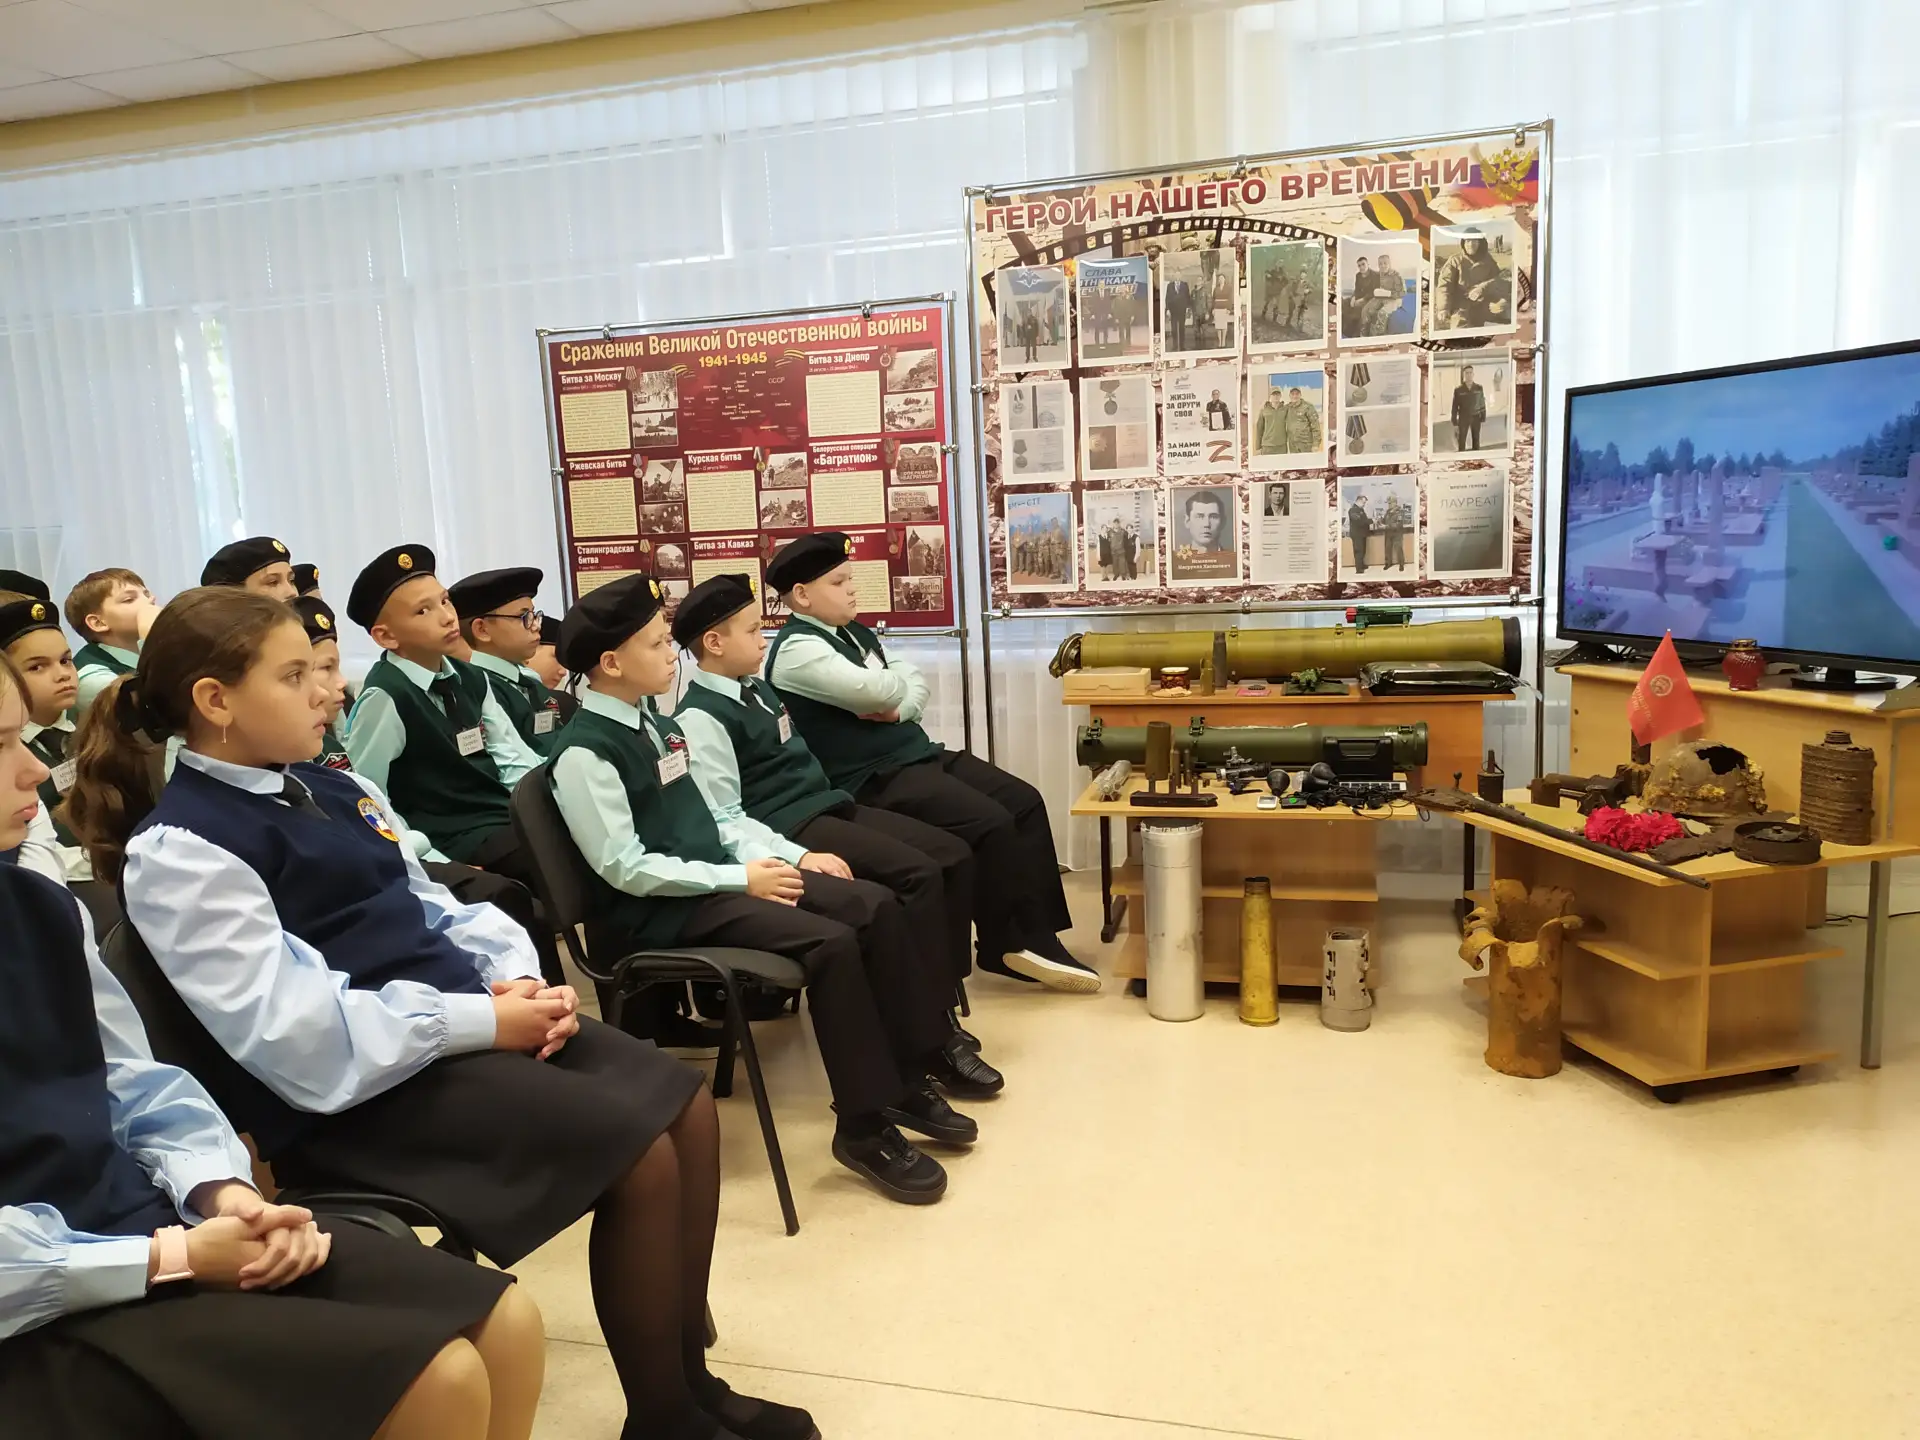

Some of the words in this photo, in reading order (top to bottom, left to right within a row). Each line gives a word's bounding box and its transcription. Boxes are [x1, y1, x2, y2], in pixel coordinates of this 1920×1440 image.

[986, 197, 1097, 233] ГЕРОИ
[1111, 178, 1267, 220] НАШЕГО
[1281, 157, 1469, 201] ВРЕМЕНИ
[1085, 268, 1122, 277] СЛАВА
[560, 340, 644, 366] Сражения
[649, 330, 721, 355] Великой
[726, 317, 861, 350] Отечественной
[808, 354, 832, 365] Битва
[833, 354, 843, 363] за
[844, 352, 870, 364] Днепр
[561, 374, 583, 384] Битва
[584, 374, 594, 383] за
[594, 372, 622, 383] Москву
[1170, 393, 1196, 401] ЖИЗНЬ
[688, 454, 719, 464] Курская
[720, 452, 742, 462] битва
[813, 453, 878, 467] «Багратион»
[1167, 450, 1201, 458] ПРАВДА!
[569, 461, 605, 471] Ржевская
[606, 459, 627, 469] битва
[1440, 495, 1499, 509] ЛАУРЕАТ
[577, 545, 634, 555] Сталинградская
[694, 541, 715, 551] Битва
[717, 541, 726, 549] за
[727, 539, 754, 549] Кавказ
[578, 556, 599, 564] битва
[920, 581, 940, 591] Berlin
